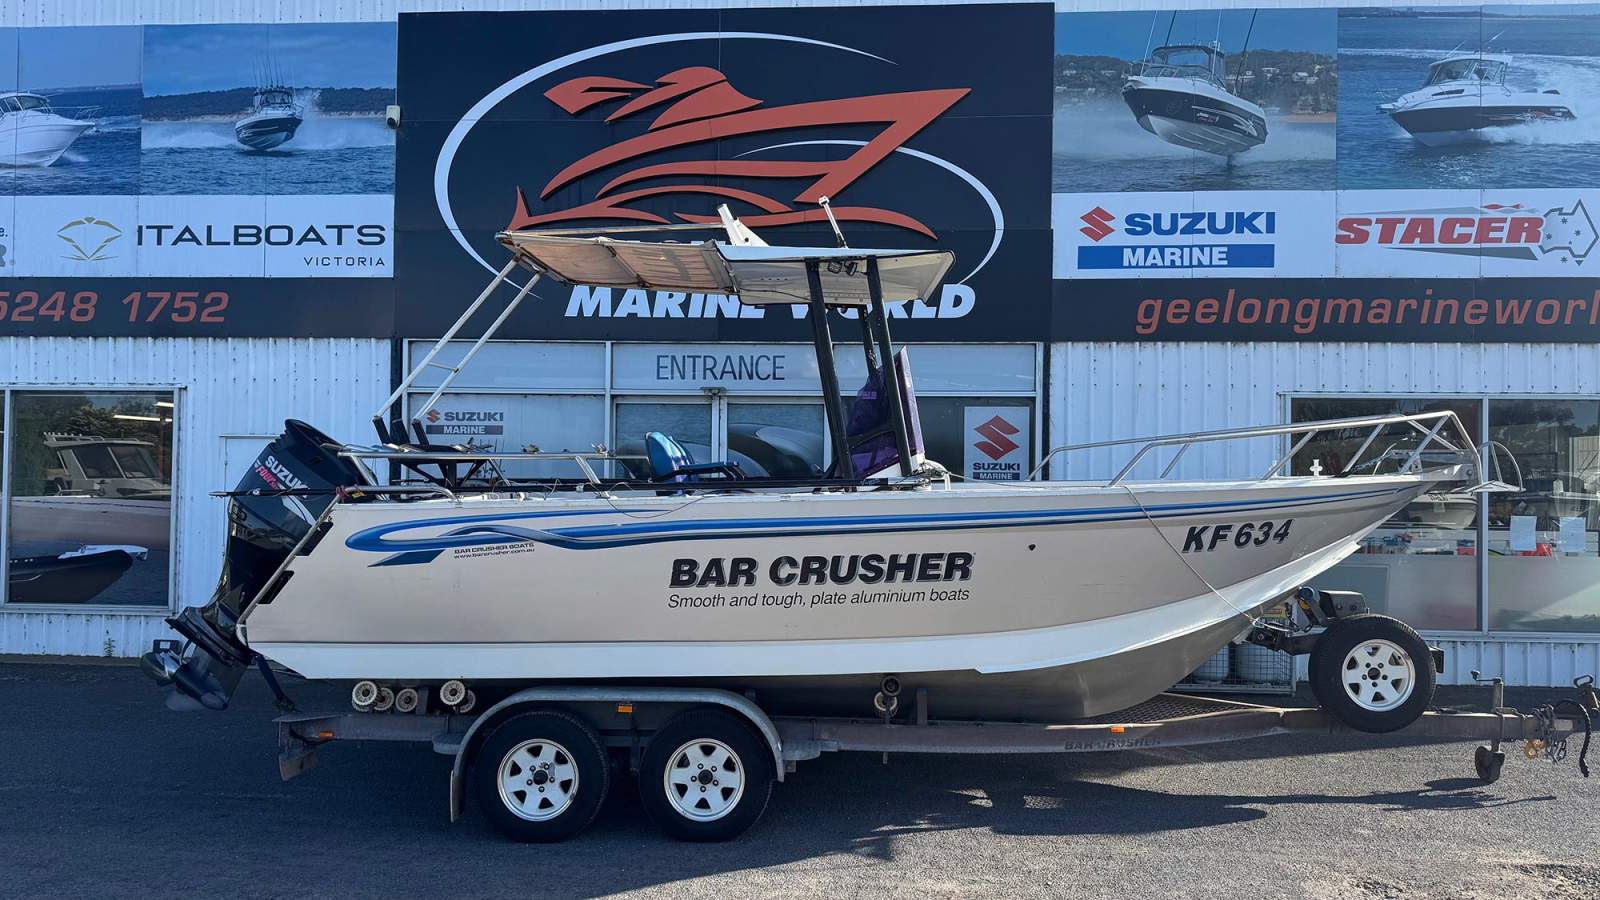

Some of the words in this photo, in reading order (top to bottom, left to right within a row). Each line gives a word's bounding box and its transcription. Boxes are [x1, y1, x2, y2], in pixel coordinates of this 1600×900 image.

[1124, 212, 1276, 236] SUZUKI
[1335, 217, 1545, 244] STACER
[137, 225, 386, 246] ITALBOATS
[303, 256, 386, 267] VICTORIA
[1123, 246, 1229, 267] MARINE
[123, 291, 229, 322] 1752
[656, 355, 786, 381] ENTRANCE
[443, 411, 504, 422] SUZUKI
[443, 426, 486, 434] MARINE
[265, 455, 311, 491] SUZUK
[973, 462, 1020, 471] SUZUKI
[454, 547, 471, 555] BAR
[472, 544, 508, 553] CRUSHER
[509, 542, 535, 550] BOATS
[669, 557, 759, 588] BAR
[769, 552, 975, 587] CRUSHER
[668, 594, 726, 608] Smooth
[729, 593, 759, 606] and
[762, 592, 806, 609] tough,
[810, 591, 847, 608] plate
[850, 589, 926, 604] aluminium
[929, 588, 970, 601] boats
